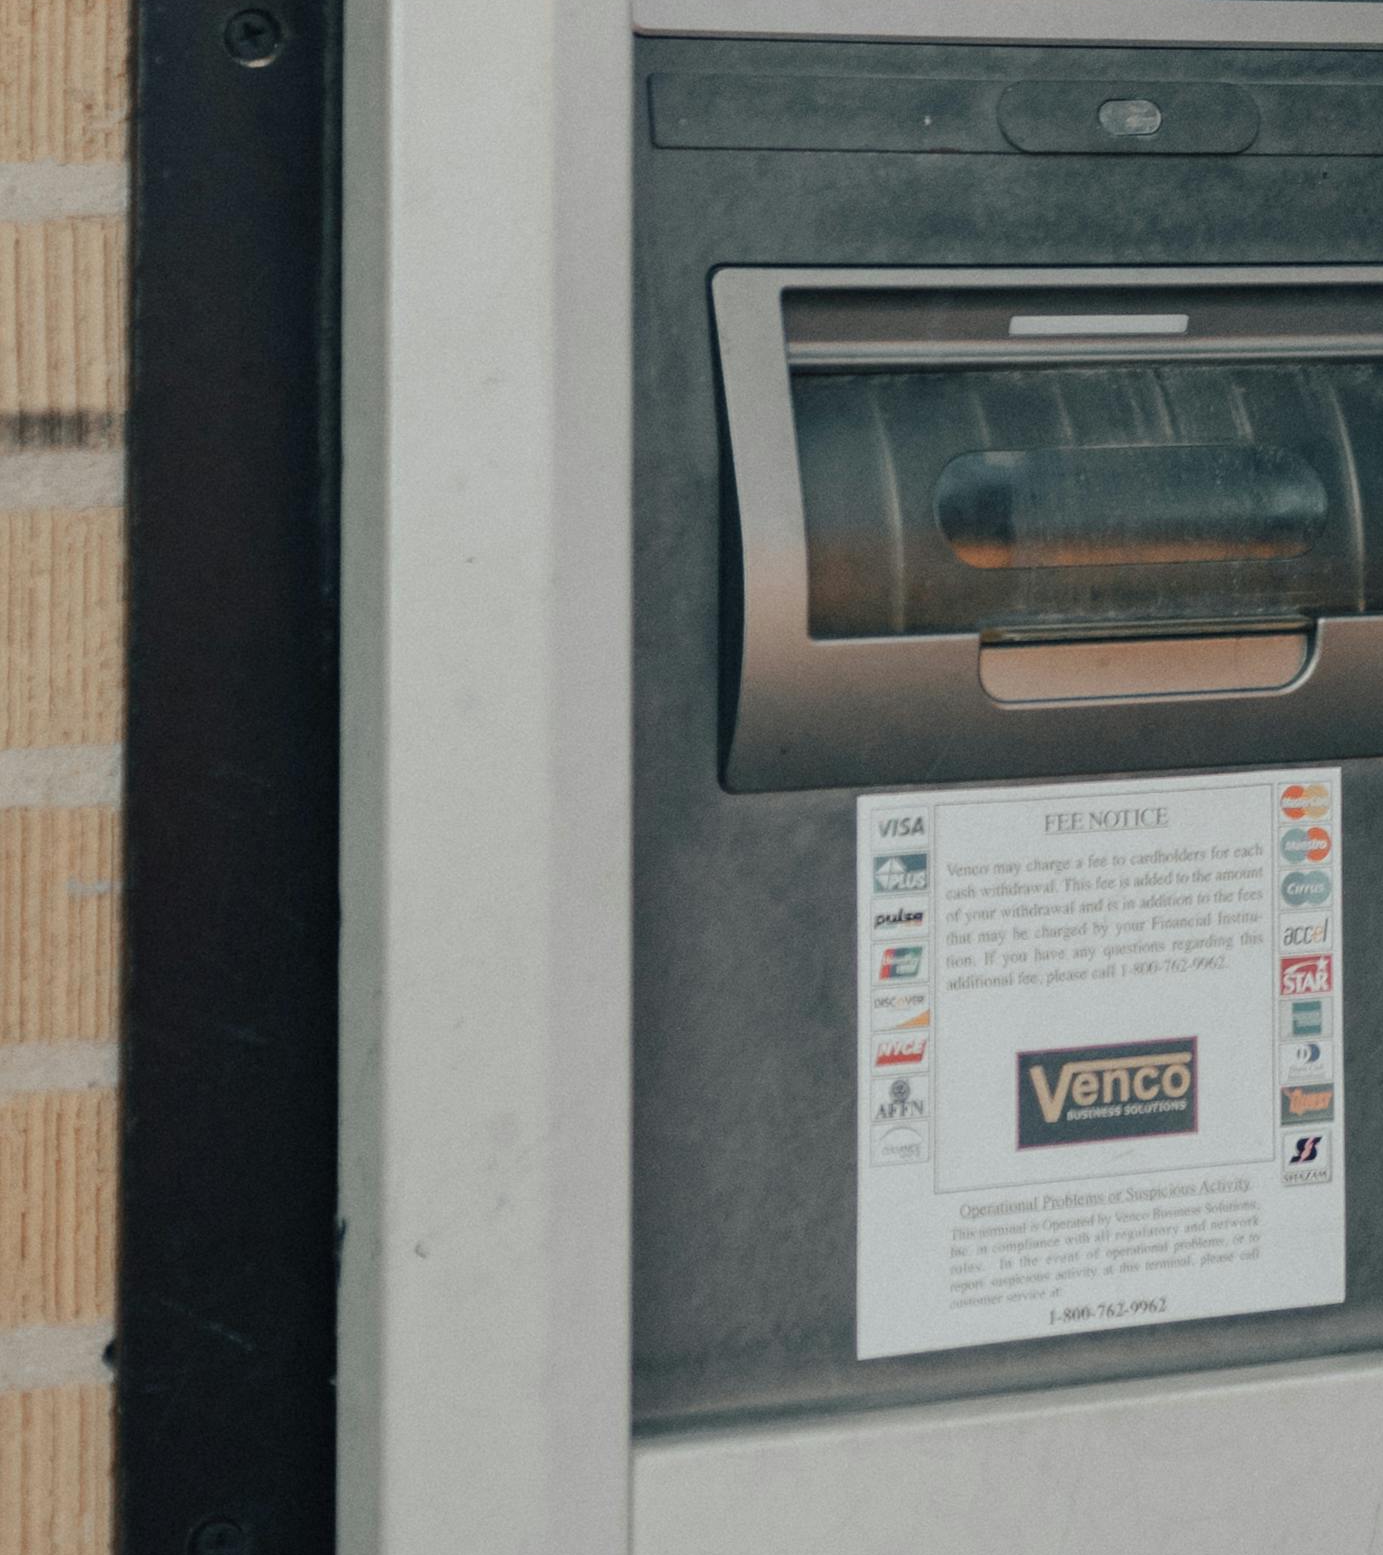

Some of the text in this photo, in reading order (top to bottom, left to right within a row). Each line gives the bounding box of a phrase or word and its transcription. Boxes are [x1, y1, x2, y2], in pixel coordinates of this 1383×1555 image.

[878, 816, 925, 838] VISA
[1045, 806, 1169, 833] FEE NOTICE
[947, 843, 1263, 877] Venco may charge a fee to cardholders for each
[890, 872, 925, 889] PLUS
[946, 885, 976, 901] cash
[1065, 877, 1091, 892] This
[1096, 876, 1118, 890] fee
[1133, 872, 1173, 888] added
[1176, 873, 1190, 884] to
[1192, 870, 1212, 883] the
[1215, 867, 1263, 881] amount
[1287, 882, 1324, 895] Cirrus
[1001, 901, 1075, 918] withdrawal
[1079, 899, 1104, 912] and
[1140, 893, 1193, 909] addition
[1213, 890, 1233, 904] the
[1237, 888, 1263, 901] fees
[874, 908, 924, 930] pulse
[978, 930, 1006, 946] may
[1034, 922, 1087, 941] charged
[1115, 920, 1146, 936] your
[1152, 913, 1212, 930] Financial
[1283, 917, 1329, 946] accel
[1002, 950, 1027, 968] you
[1034, 947, 1065, 962] have
[1072, 946, 1096, 961] any
[1103, 940, 1165, 960] questions
[1172, 934, 1233, 953] regarding
[1240, 932, 1264, 946] this
[946, 973, 1013, 991] additional
[1046, 968, 1088, 987] please
[1091, 963, 1116, 979] call
[1283, 969, 1328, 993] STAR
[874, 995, 924, 1009] DISCOVER
[879, 1039, 926, 1056] NYCE
[1028, 1051, 1192, 1124] Venco
[875, 1100, 924, 1120] AFFN
[1066, 1100, 1187, 1122] BUSINESS SOLUTIONS
[959, 1178, 1250, 1220] Operational Problems or Suspicious Activity
[1042, 1213, 1094, 1232] Operated
[1049, 1296, 1168, 1326] 1-800-762-9962
